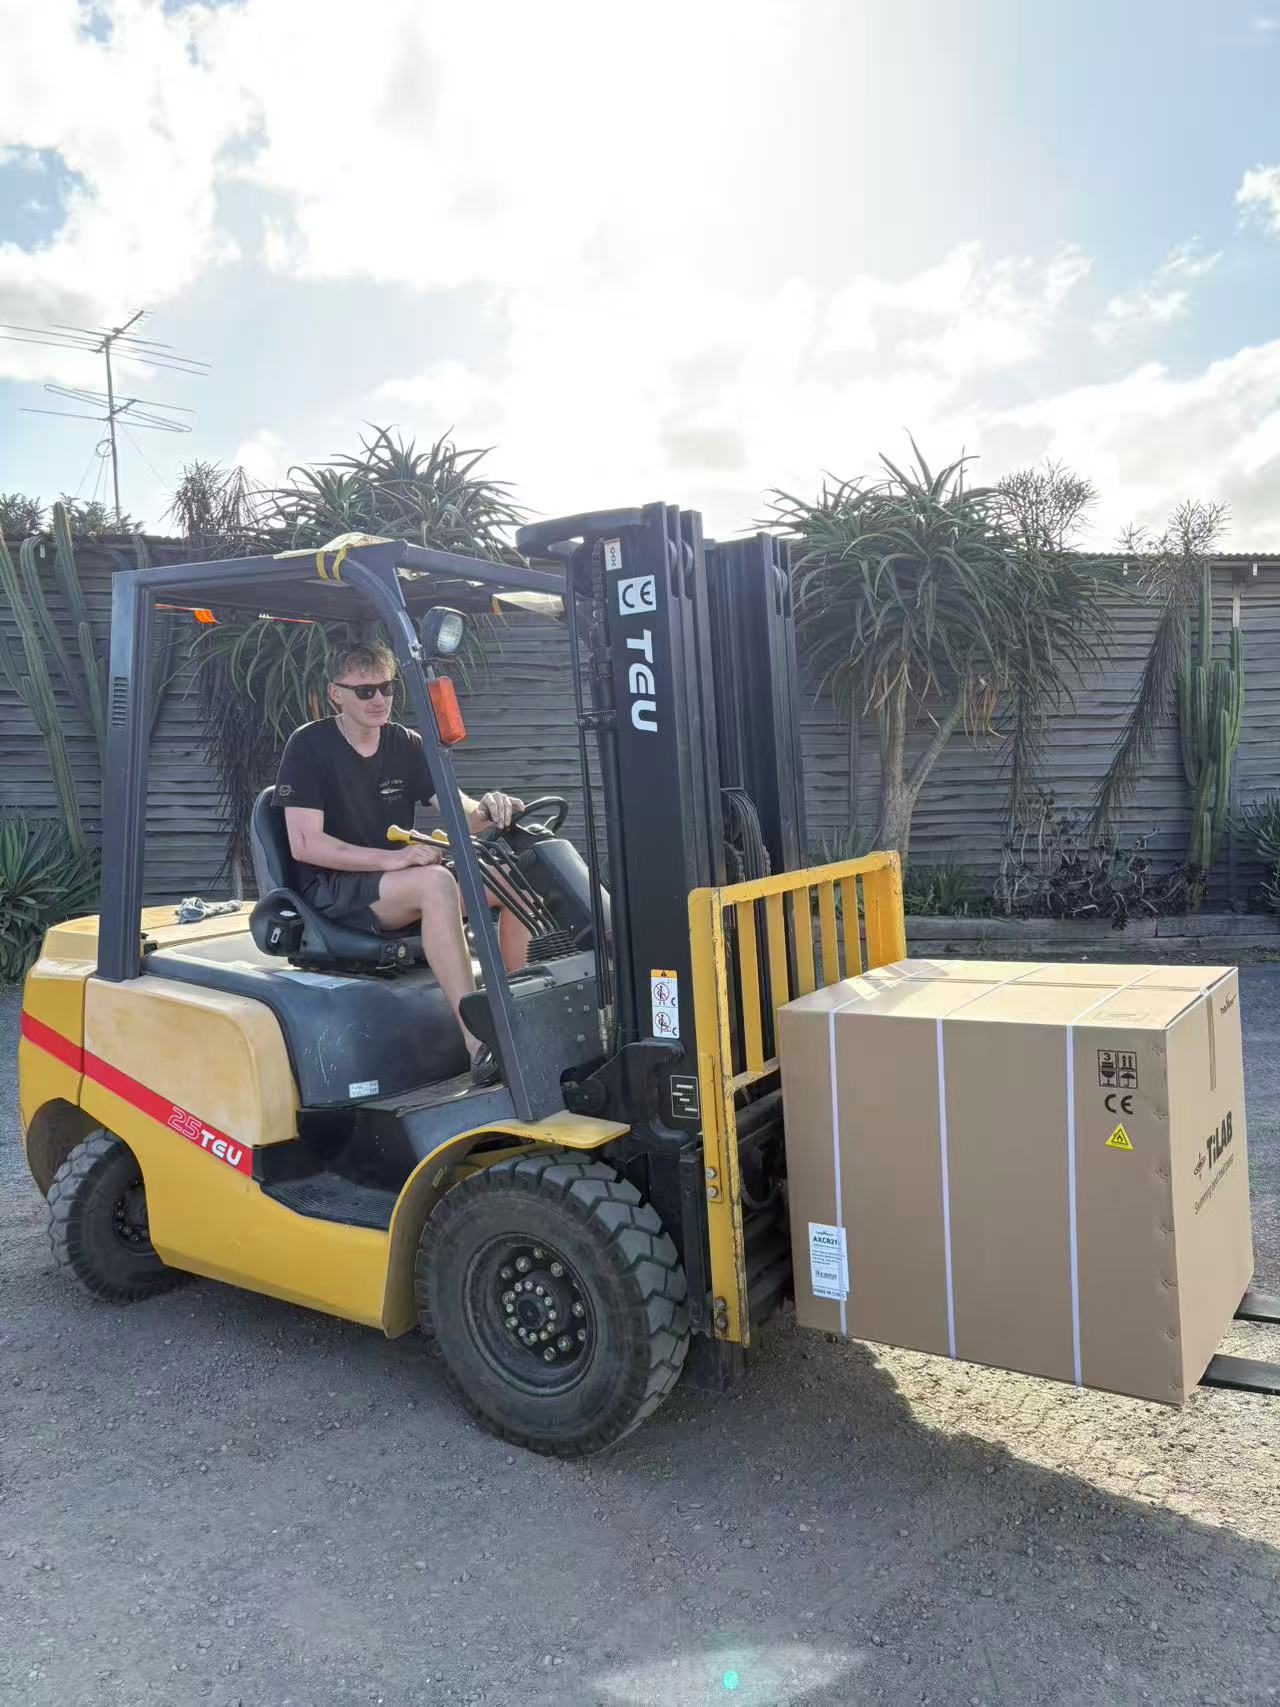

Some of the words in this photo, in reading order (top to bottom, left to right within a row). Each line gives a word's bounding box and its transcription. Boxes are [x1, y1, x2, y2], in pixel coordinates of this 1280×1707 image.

[621, 580, 653, 609] CE
[626, 628, 658, 733] TEU
[1103, 1052, 1111, 1061] 3
[1104, 1093, 1134, 1115] CE
[167, 1106, 202, 1140] 25
[201, 1129, 243, 1166] TEU
